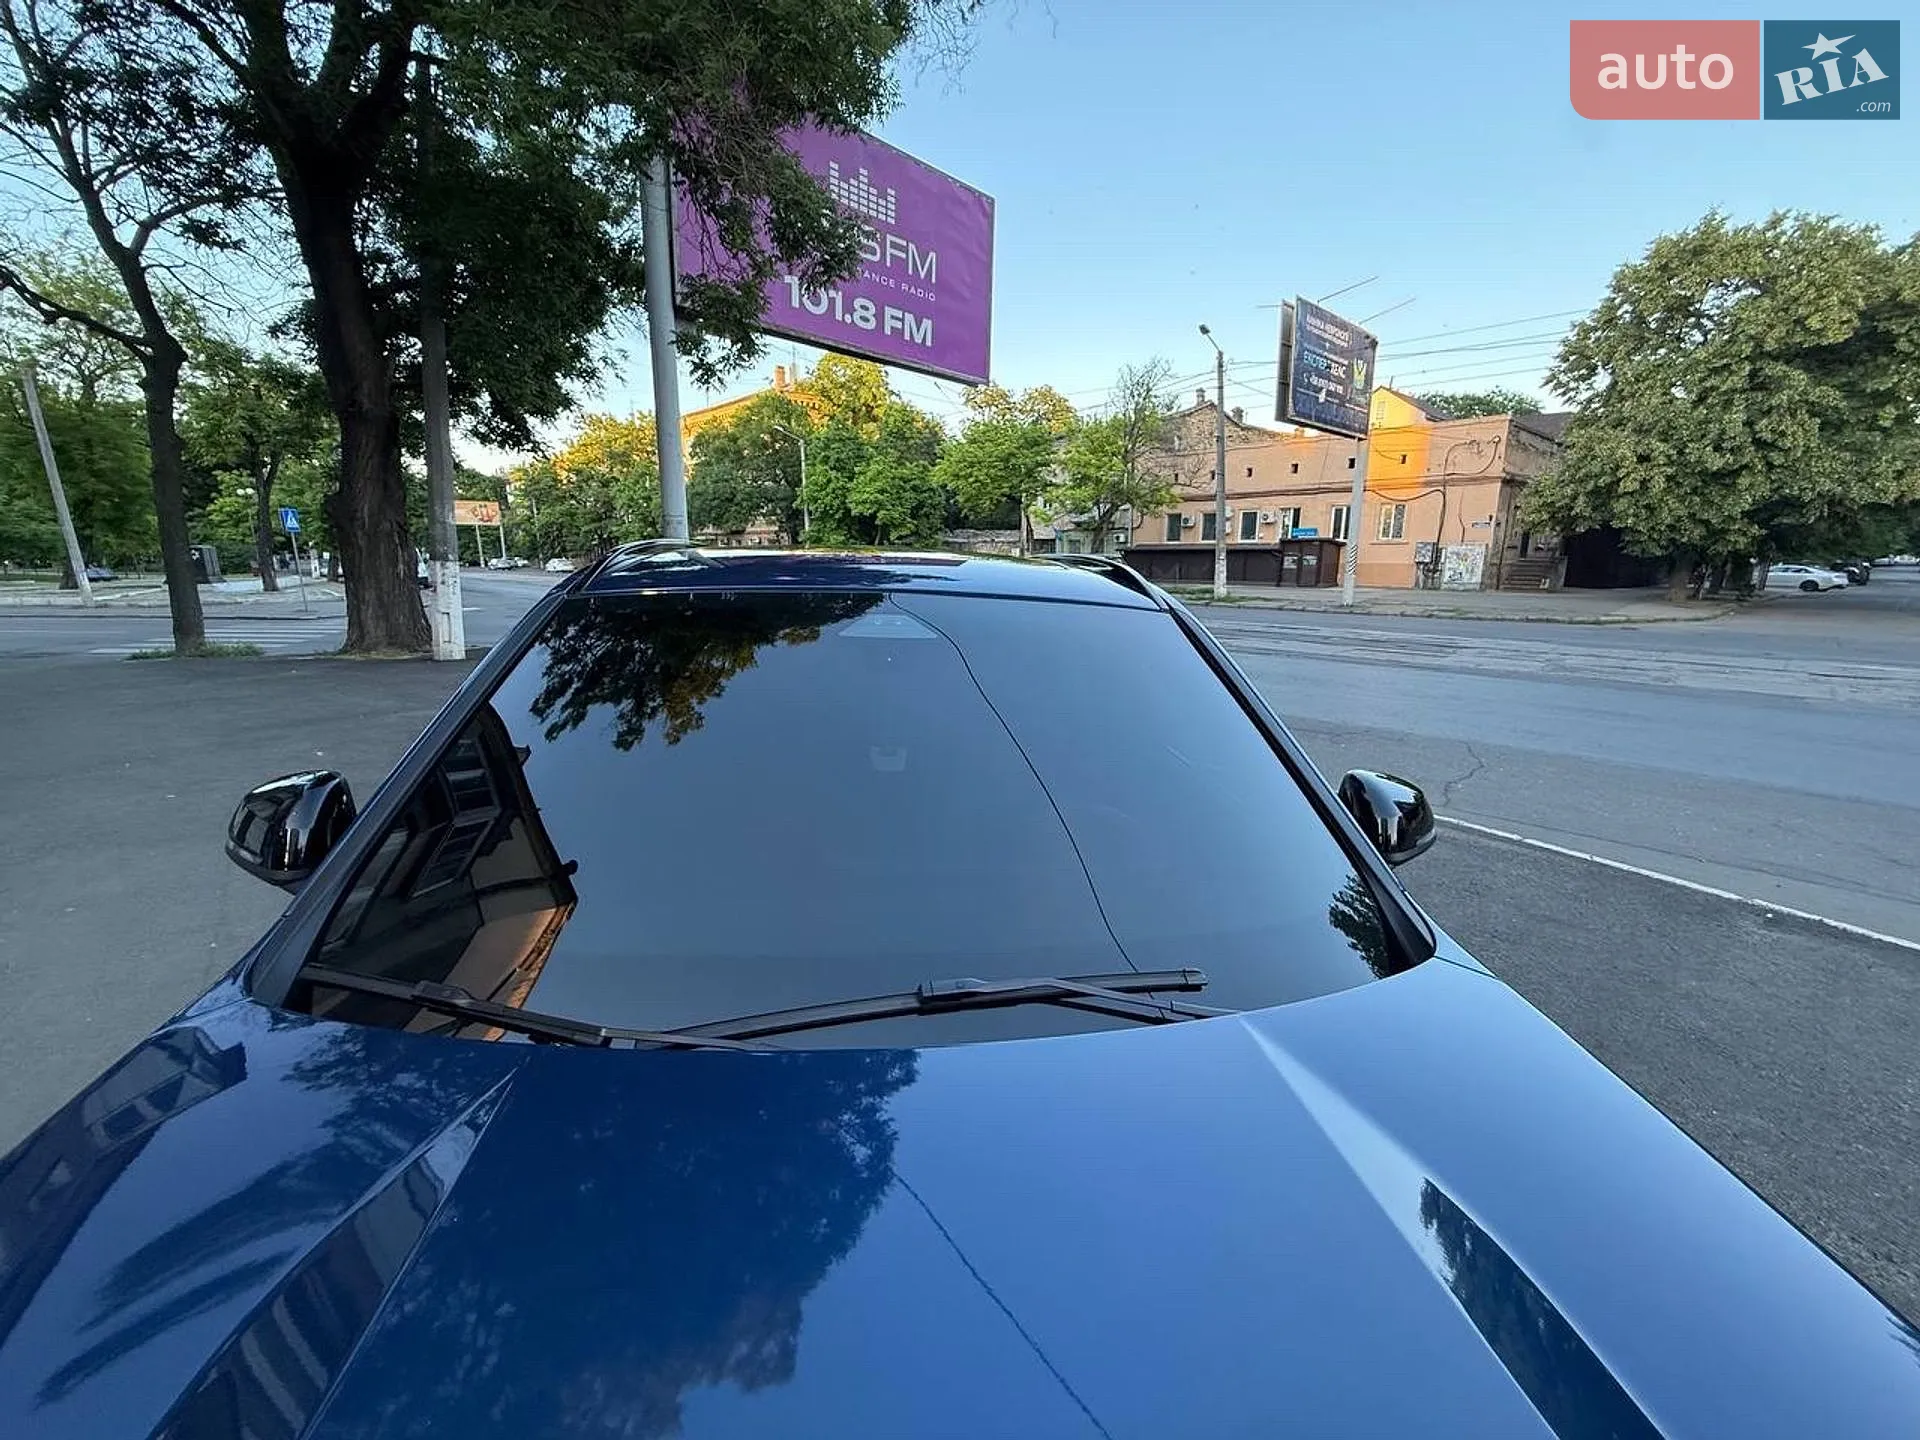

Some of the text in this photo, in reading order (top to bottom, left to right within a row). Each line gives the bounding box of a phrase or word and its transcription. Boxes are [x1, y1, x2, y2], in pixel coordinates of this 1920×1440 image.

[784, 274, 933, 347] 101.8 FM
[901, 281, 937, 301] RADIO
